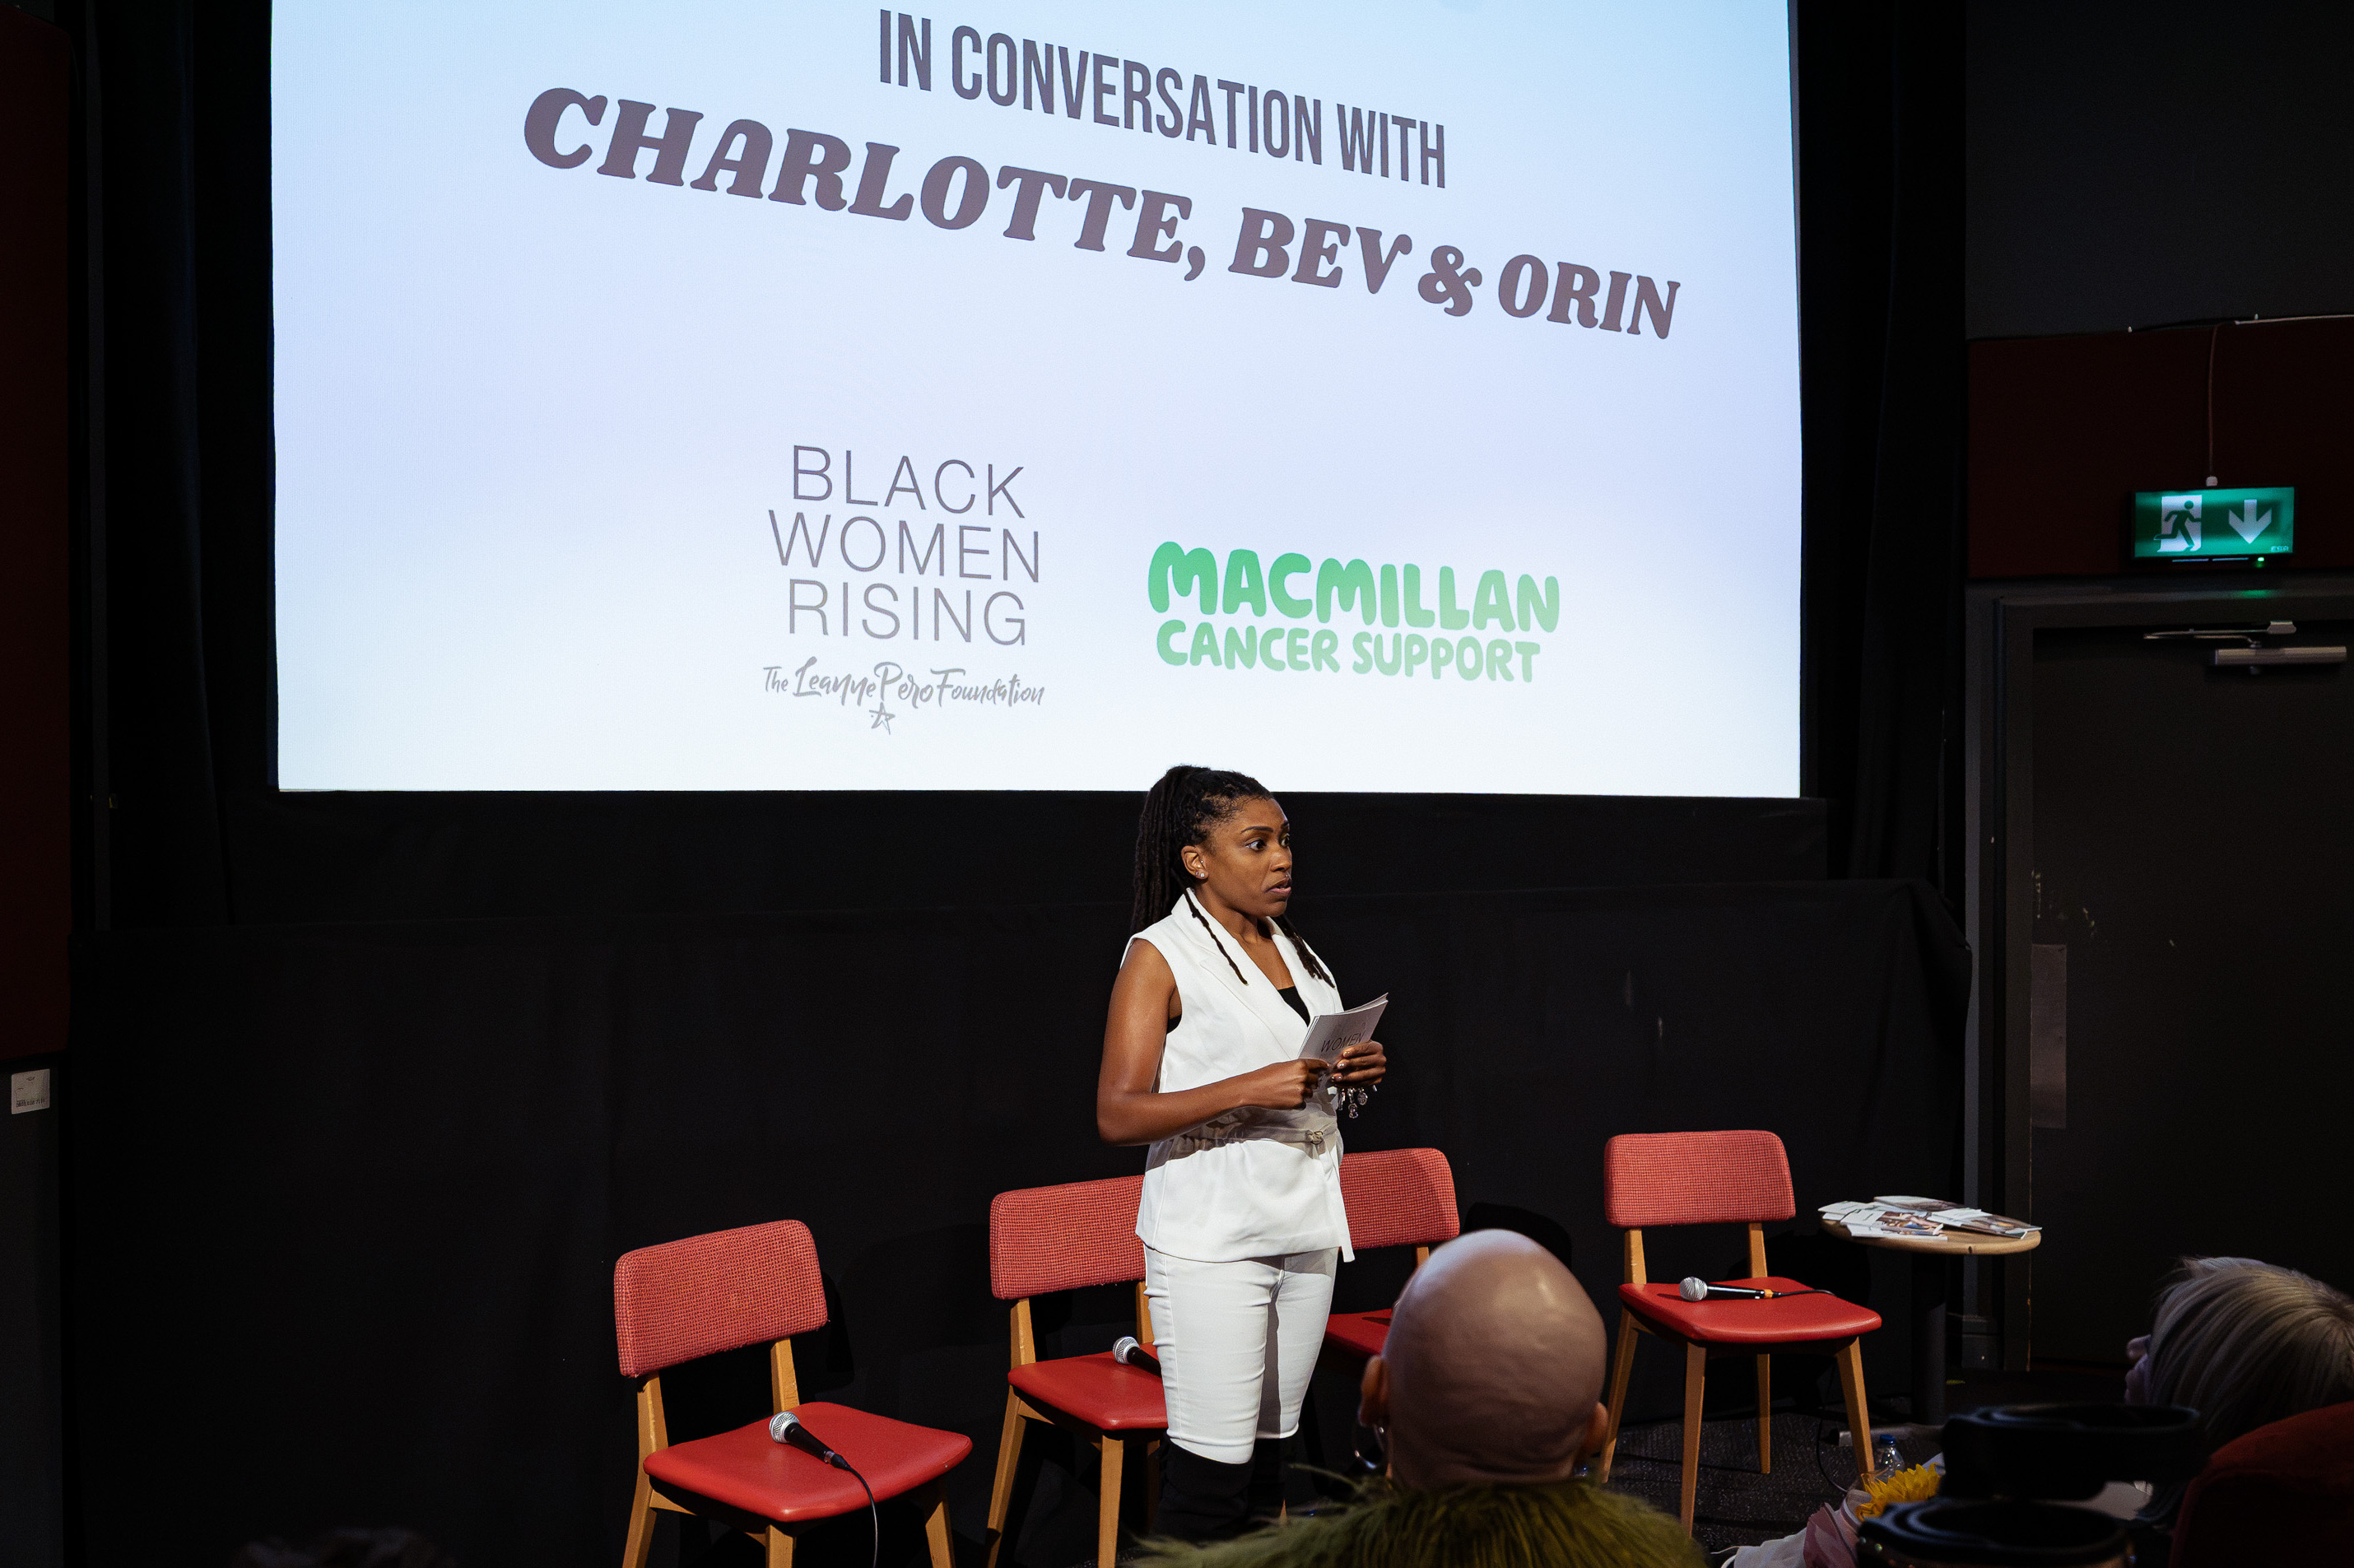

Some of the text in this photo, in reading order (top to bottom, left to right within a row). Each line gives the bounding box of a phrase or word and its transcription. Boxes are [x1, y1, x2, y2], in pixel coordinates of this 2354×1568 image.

[879, 8, 1446, 189] IN CONVERSATION WITH
[523, 86, 1681, 340] CHARLOTTE, BEV & ORIN
[793, 444, 1026, 519] BLACK
[768, 509, 1040, 584] WOMEN
[789, 579, 1026, 646] RISING
[1147, 541, 1561, 633] MACMILLAN
[763, 656, 1045, 709] The Leanne Pero Foundation
[1156, 619, 1541, 682] CANCER SUPPORT
[1320, 1029, 1366, 1054] WOMEN
